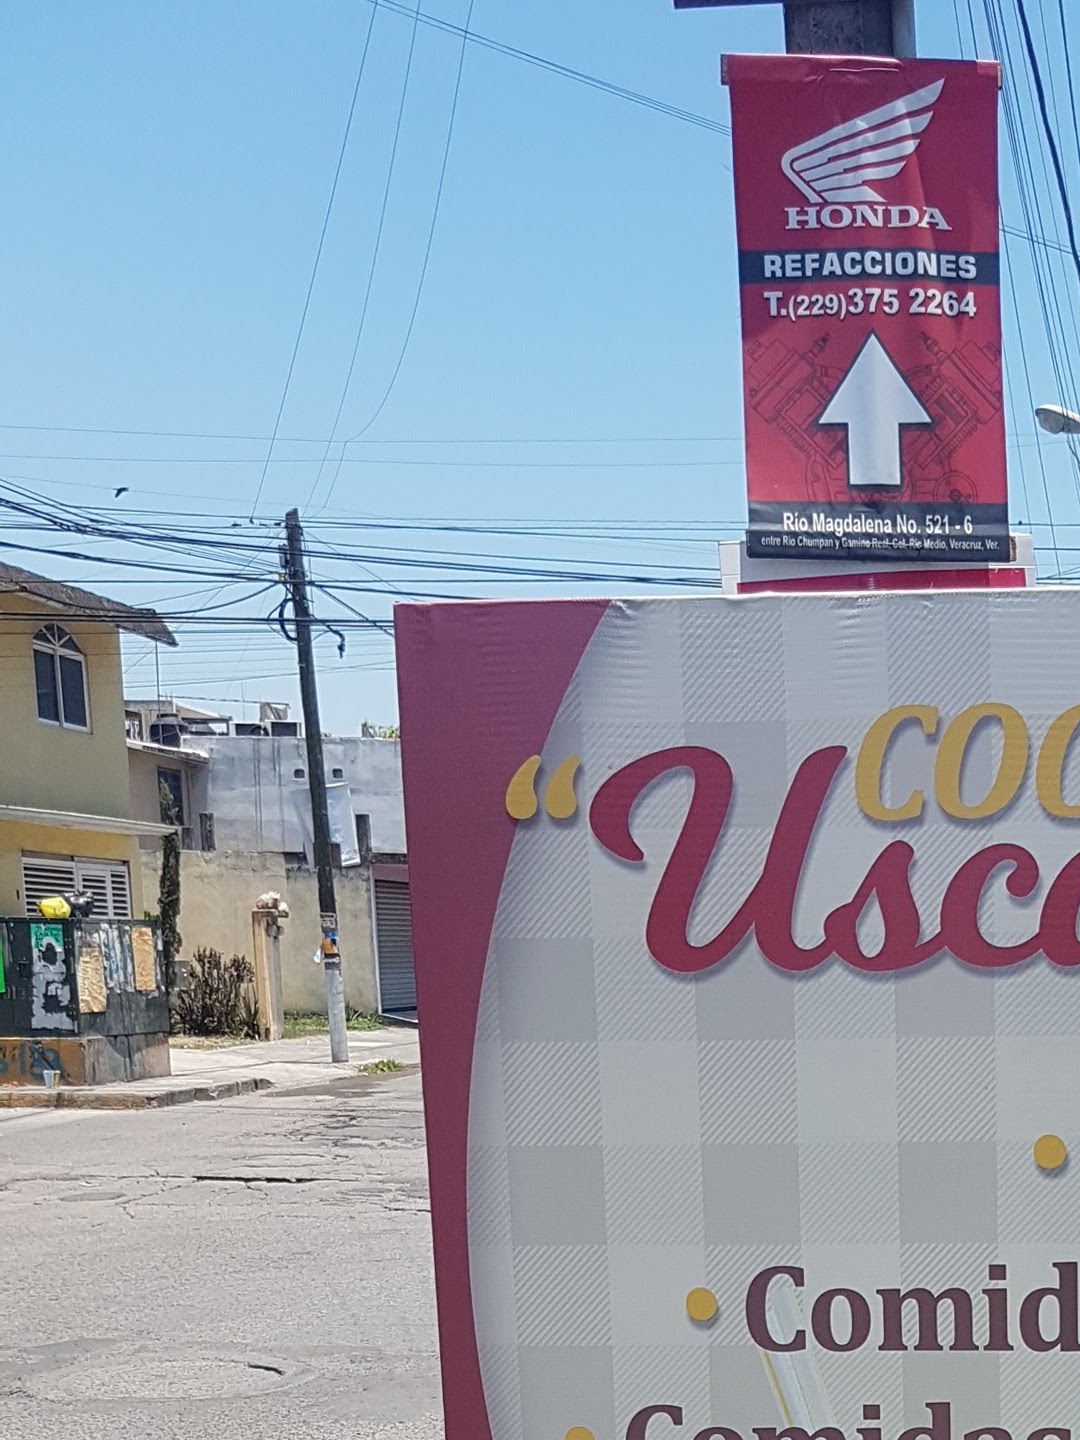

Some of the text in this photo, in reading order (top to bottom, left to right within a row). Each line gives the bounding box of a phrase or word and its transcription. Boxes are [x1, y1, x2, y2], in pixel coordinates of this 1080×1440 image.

[784, 204, 953, 231] HONDA
[763, 251, 978, 280] REFACCIONES
[908, 288, 977, 318] 2264
[783, 511, 808, 532] Río
[812, 512, 893, 537] Magdalena
[896, 514, 921, 534] No.
[925, 514, 949, 534] 521
[963, 515, 973, 535] 6
[761, 536, 781, 546] entre
[834, 538, 840, 550] y
